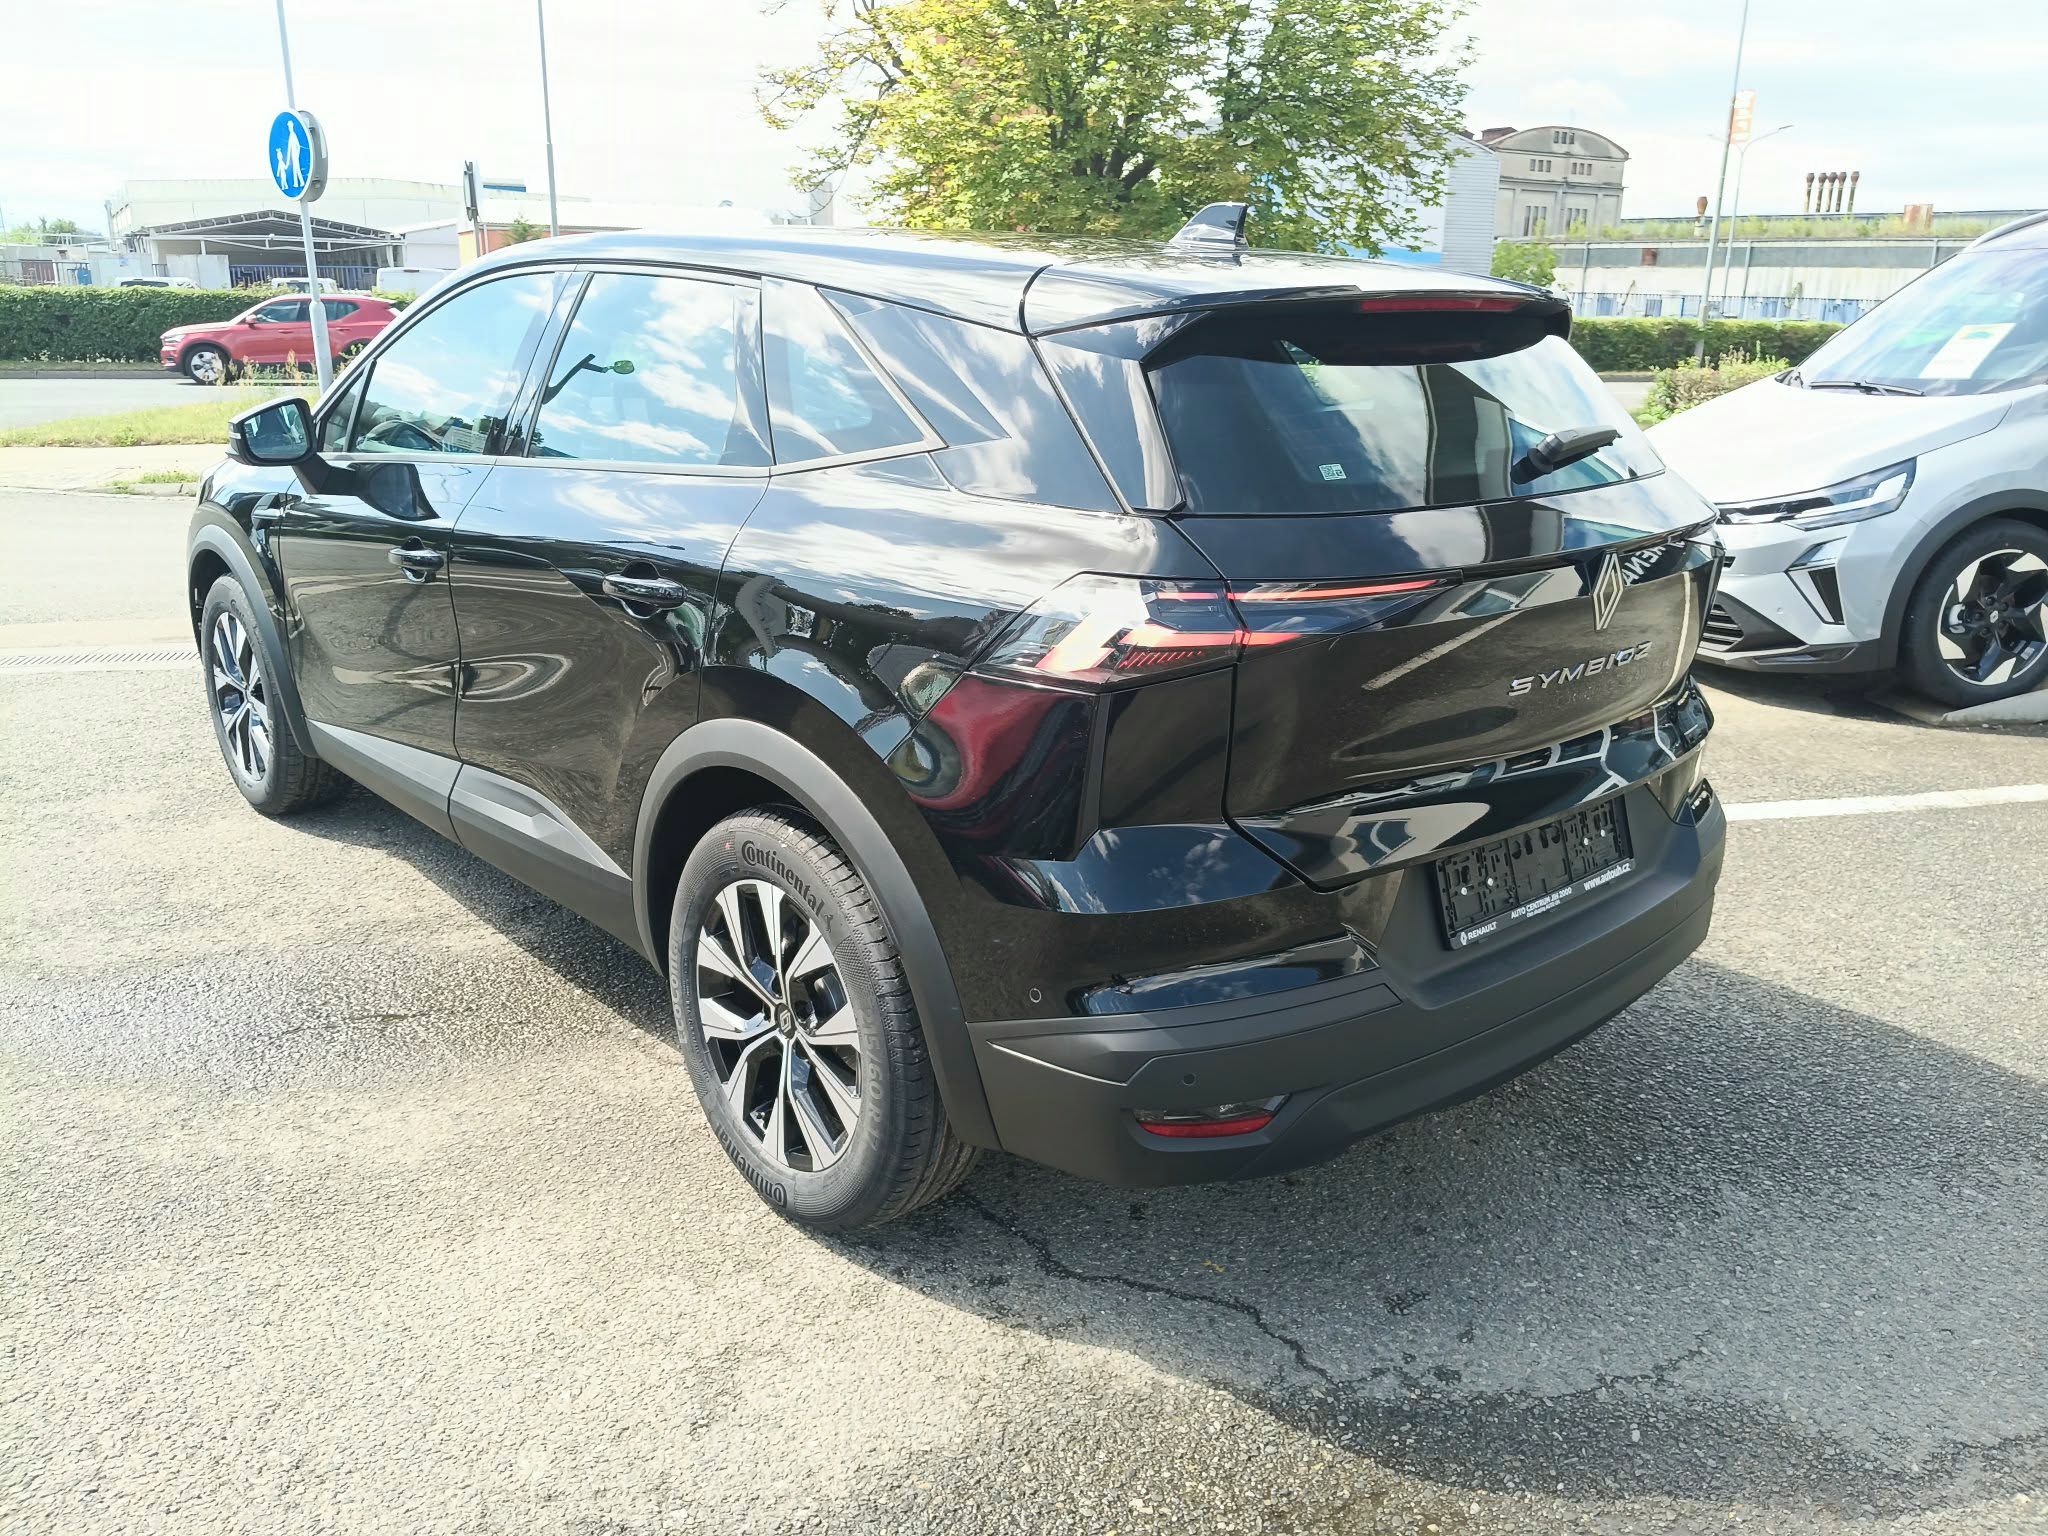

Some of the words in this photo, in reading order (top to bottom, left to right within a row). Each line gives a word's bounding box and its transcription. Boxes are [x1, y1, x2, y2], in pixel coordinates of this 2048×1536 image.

[1508, 640, 1653, 697] SYMBIOZ
[741, 840, 826, 917] Continental
[1467, 921, 1498, 940] RENAULT
[1511, 907, 1526, 919] AUTO
